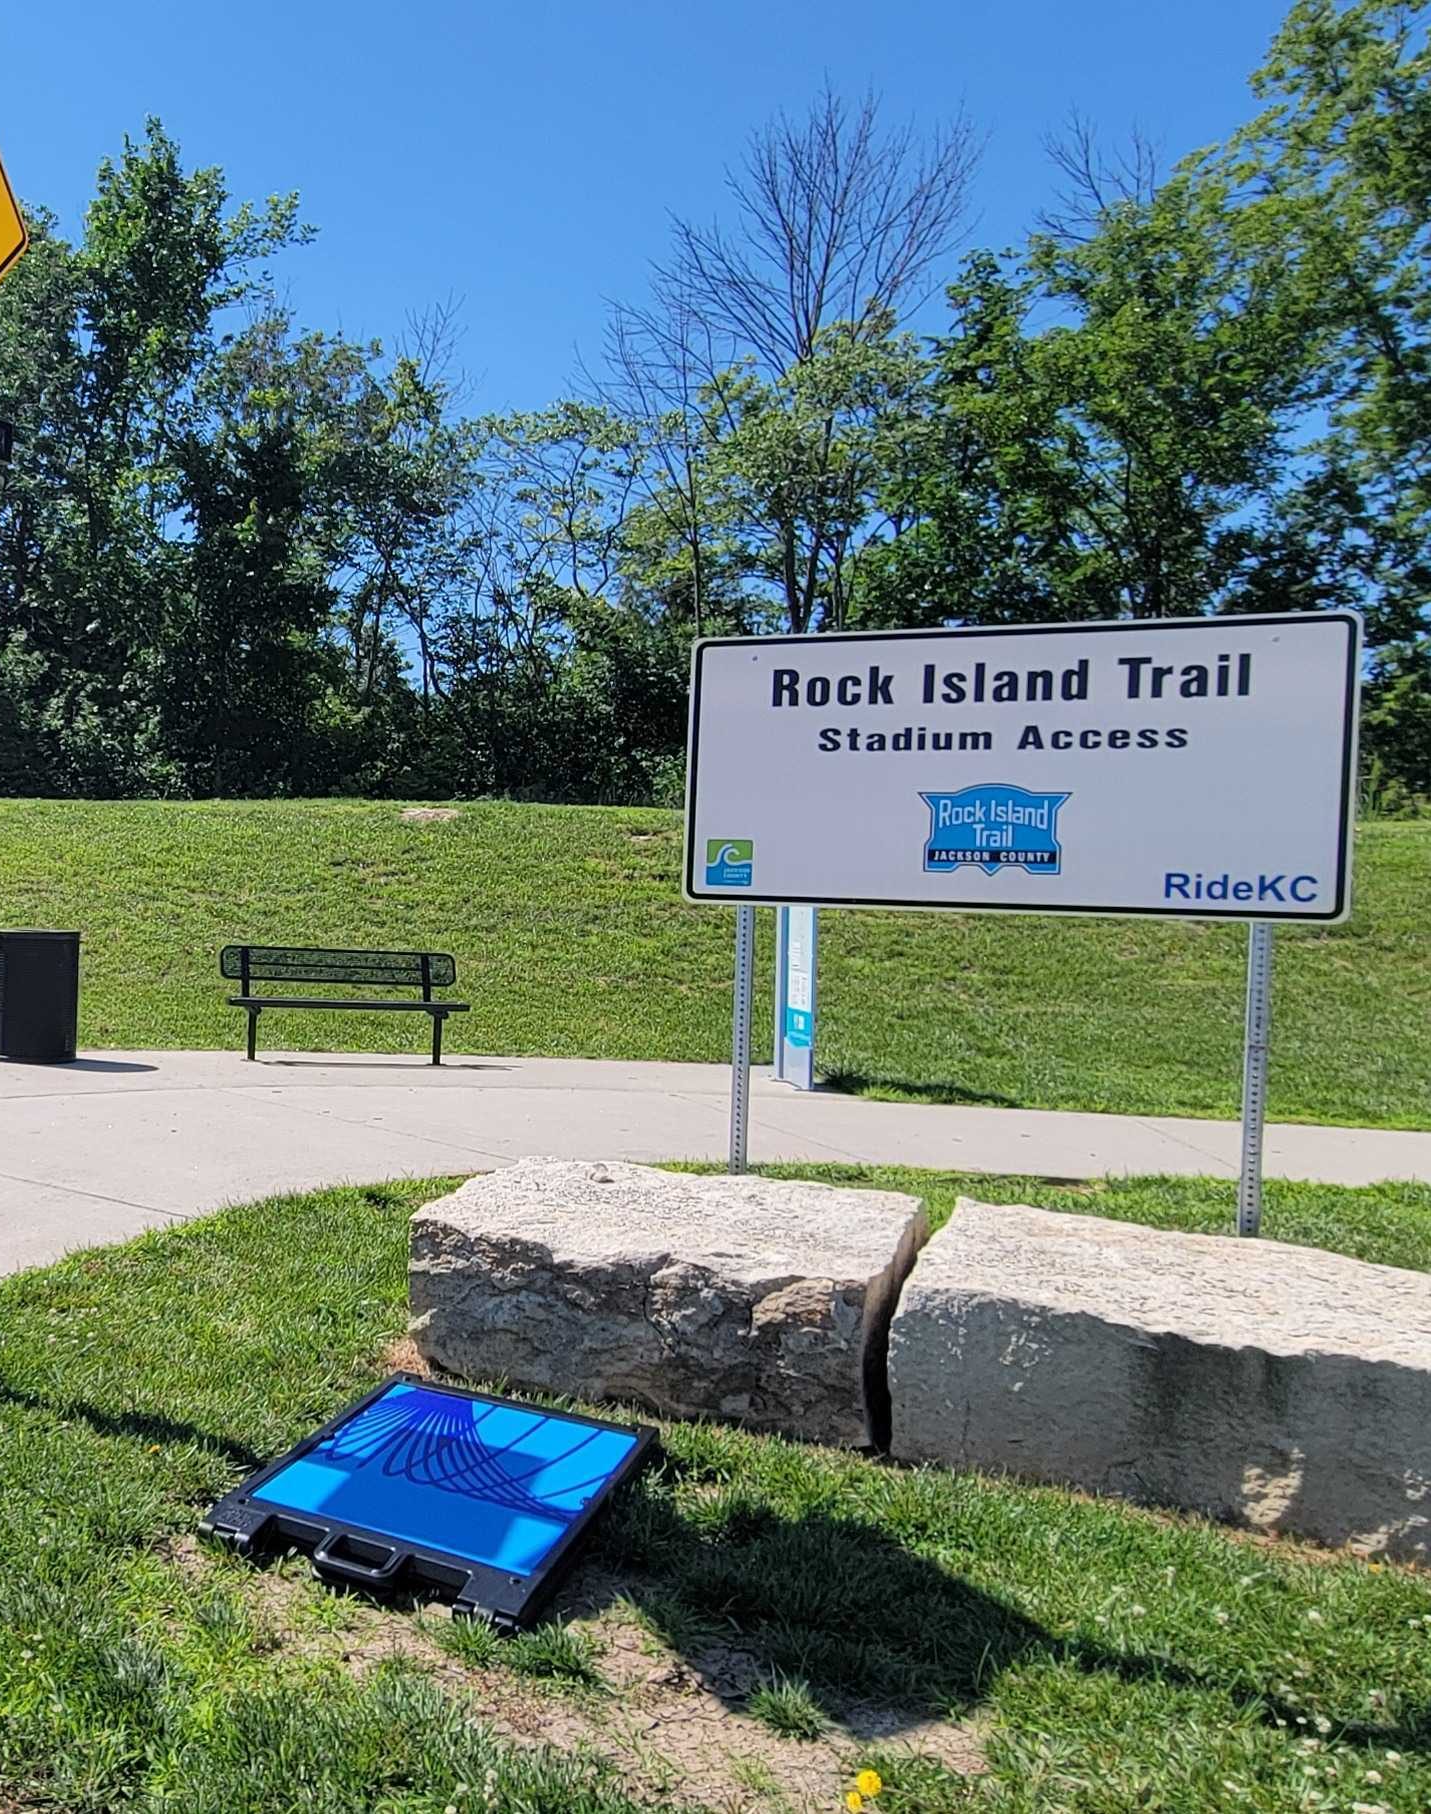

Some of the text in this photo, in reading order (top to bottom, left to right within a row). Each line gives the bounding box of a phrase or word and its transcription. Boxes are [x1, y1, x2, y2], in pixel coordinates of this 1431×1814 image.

[772, 653, 1252, 707] Rock Island Trail
[818, 725, 1189, 752] Stadium Access
[938, 799, 1049, 830] Rock Island
[972, 823, 1013, 848] Trail
[933, 850, 1051, 862] JACKSON COUNTY
[1164, 872, 1318, 903] RideKC
